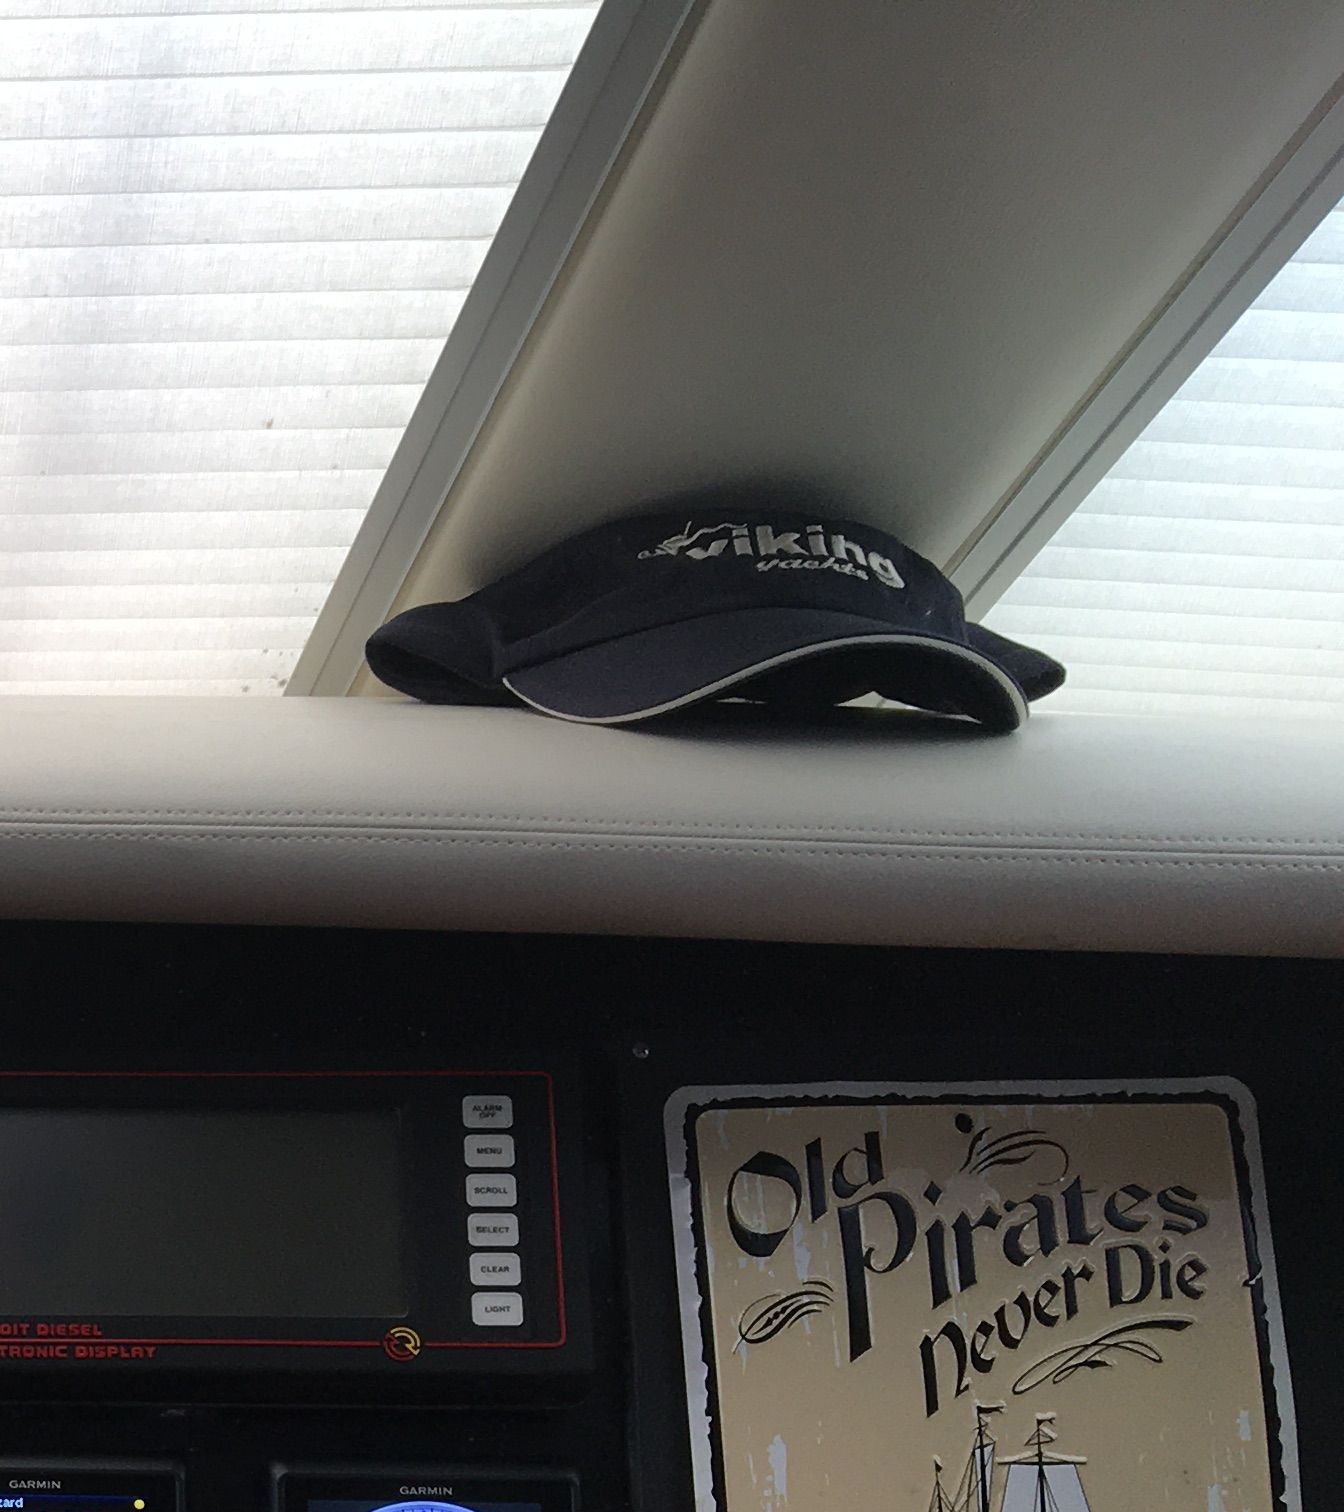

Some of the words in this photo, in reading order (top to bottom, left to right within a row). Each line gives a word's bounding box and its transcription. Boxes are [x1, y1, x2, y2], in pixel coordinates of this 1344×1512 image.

[727, 1131, 884, 1258] Old
[836, 1174, 1209, 1363] Pirates
[1106, 1244, 1209, 1308] Die
[37, 1324, 103, 1337] DIESEL
[75, 1346, 156, 1359] DISPLAY
[9, 1480, 61, 1489] GARMIN
[400, 1486, 452, 1495] GARMIN
